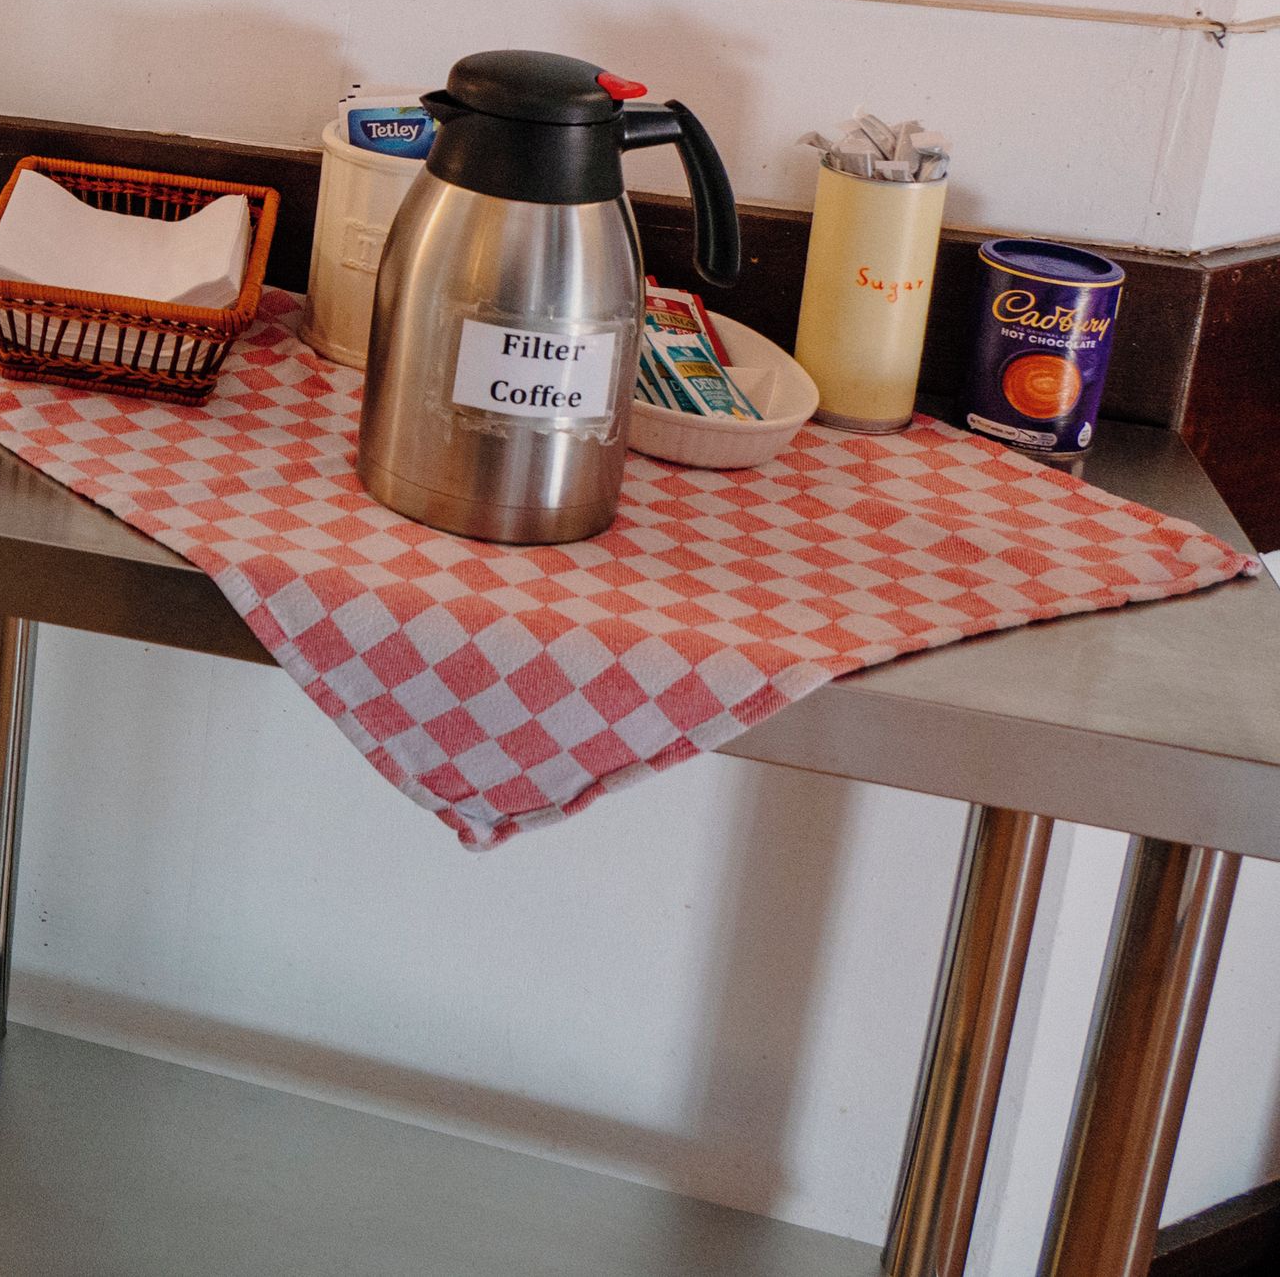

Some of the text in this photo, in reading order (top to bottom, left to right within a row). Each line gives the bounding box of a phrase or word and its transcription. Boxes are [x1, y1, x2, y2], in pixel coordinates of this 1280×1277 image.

[366, 122, 420, 142] Tetley
[856, 266, 925, 303] Sugar
[991, 289, 1111, 341] Cadbury
[501, 333, 586, 363] Filter
[1000, 327, 1096, 349] HOT CHOCOLATE
[490, 379, 582, 408] Coffee
